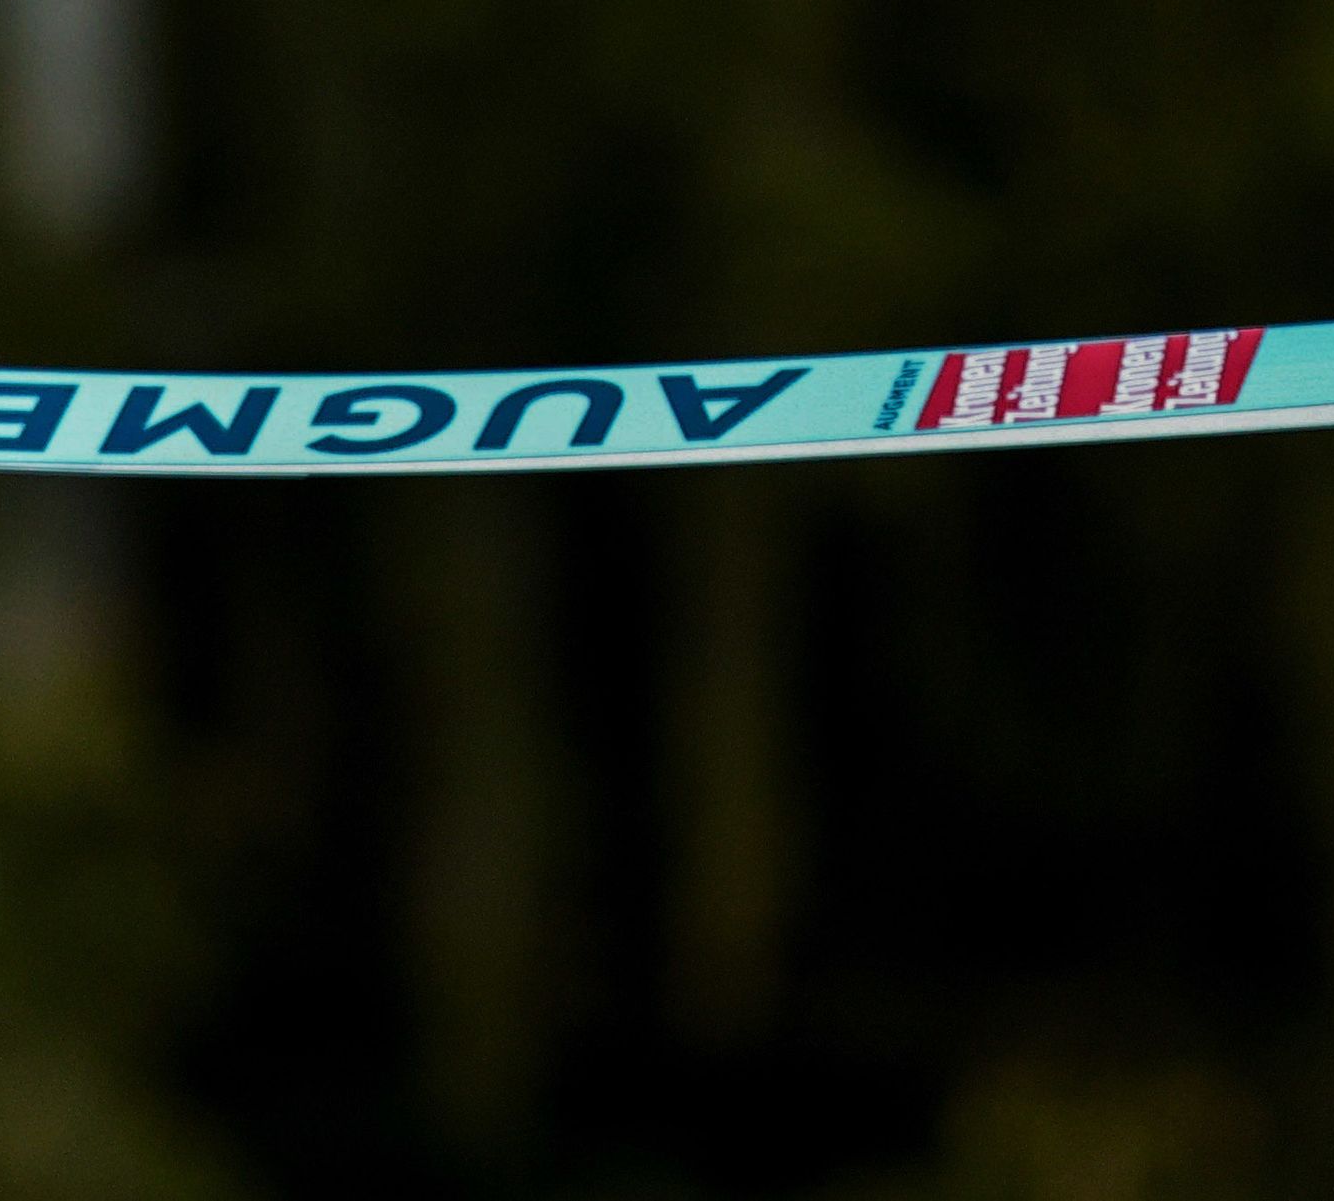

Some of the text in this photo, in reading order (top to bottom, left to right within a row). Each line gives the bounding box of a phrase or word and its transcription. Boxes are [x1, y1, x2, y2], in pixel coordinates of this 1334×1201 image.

[873, 360, 926, 432] AUGMENT
[938, 350, 1007, 429] Kronen
[1004, 344, 1079, 423] Zeitung
[1099, 337, 1167, 416] Kronen
[1165, 331, 1239, 410] Zeitung
